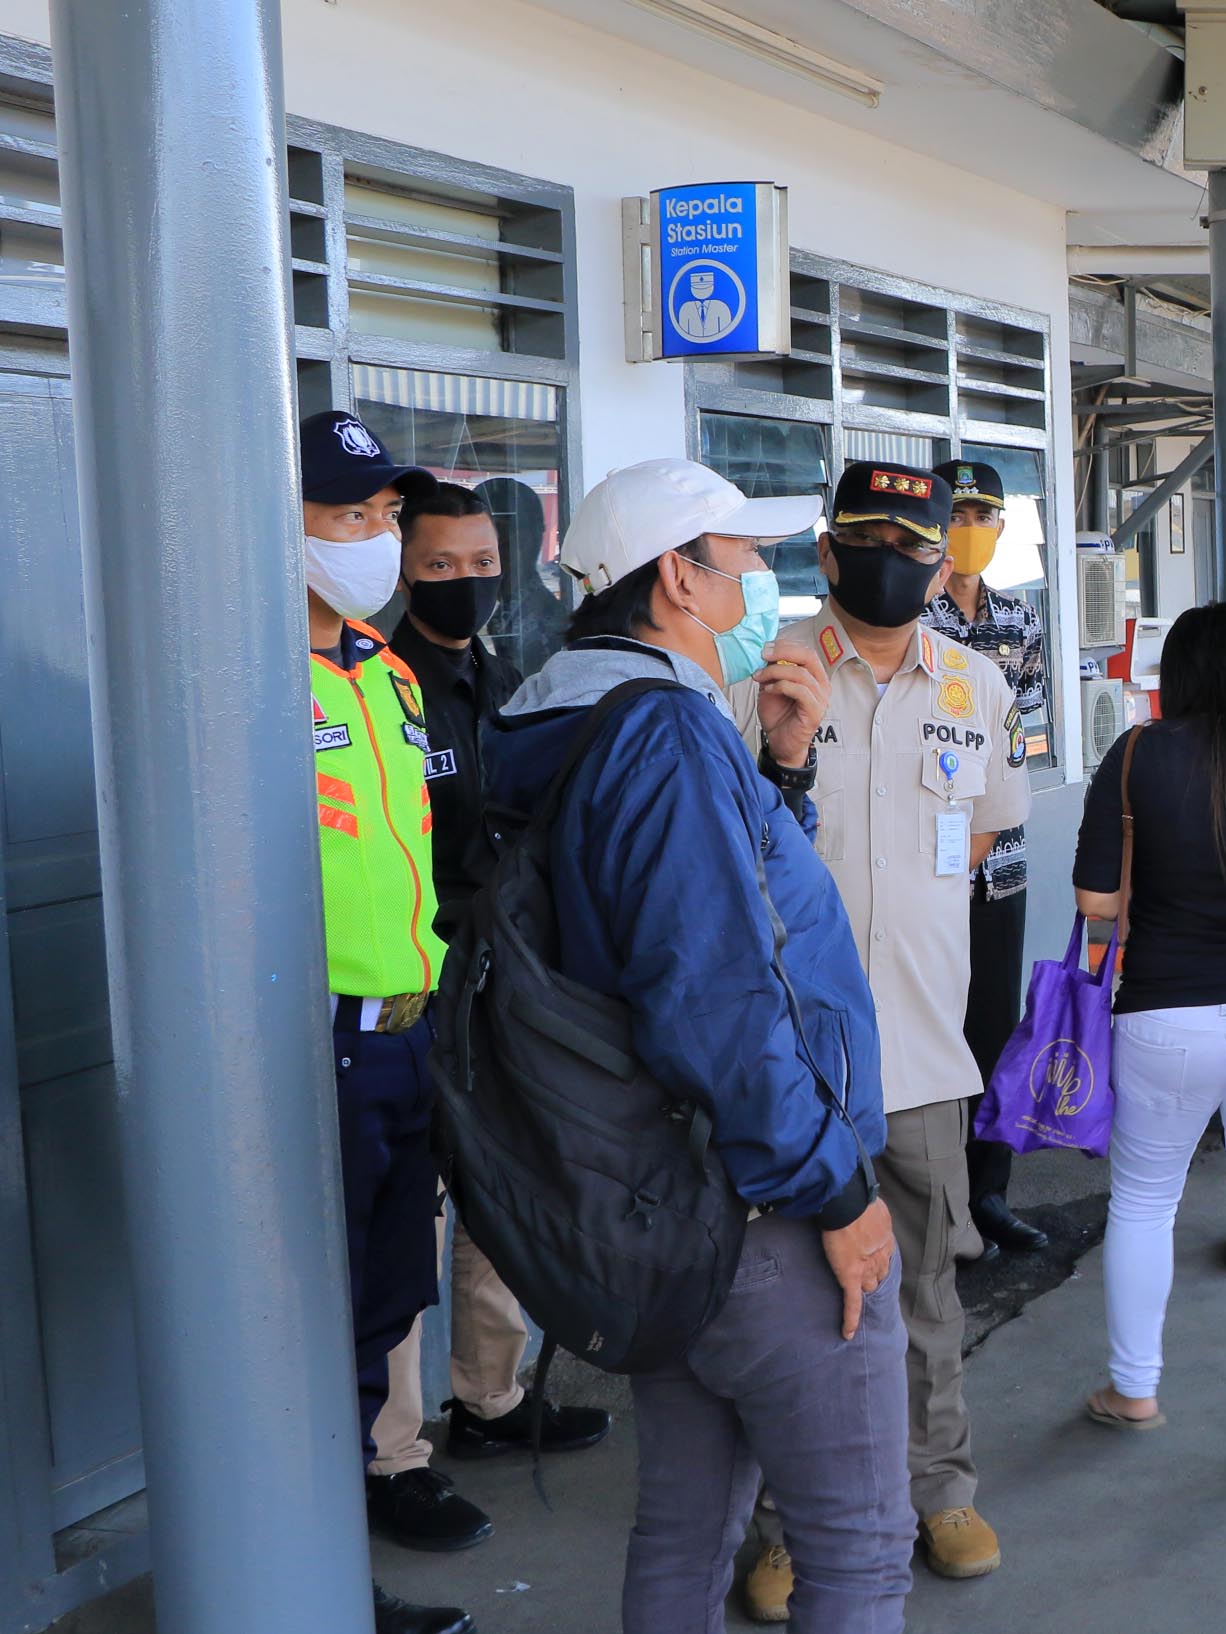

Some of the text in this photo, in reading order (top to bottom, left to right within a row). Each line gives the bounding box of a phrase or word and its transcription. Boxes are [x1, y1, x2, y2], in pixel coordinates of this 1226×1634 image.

[666, 193, 742, 219] Kepala
[667, 220, 742, 243] Stasiun
[671, 243, 738, 257] Station Master
[923, 723, 985, 751] POL PP
[441, 754, 449, 771] 2
